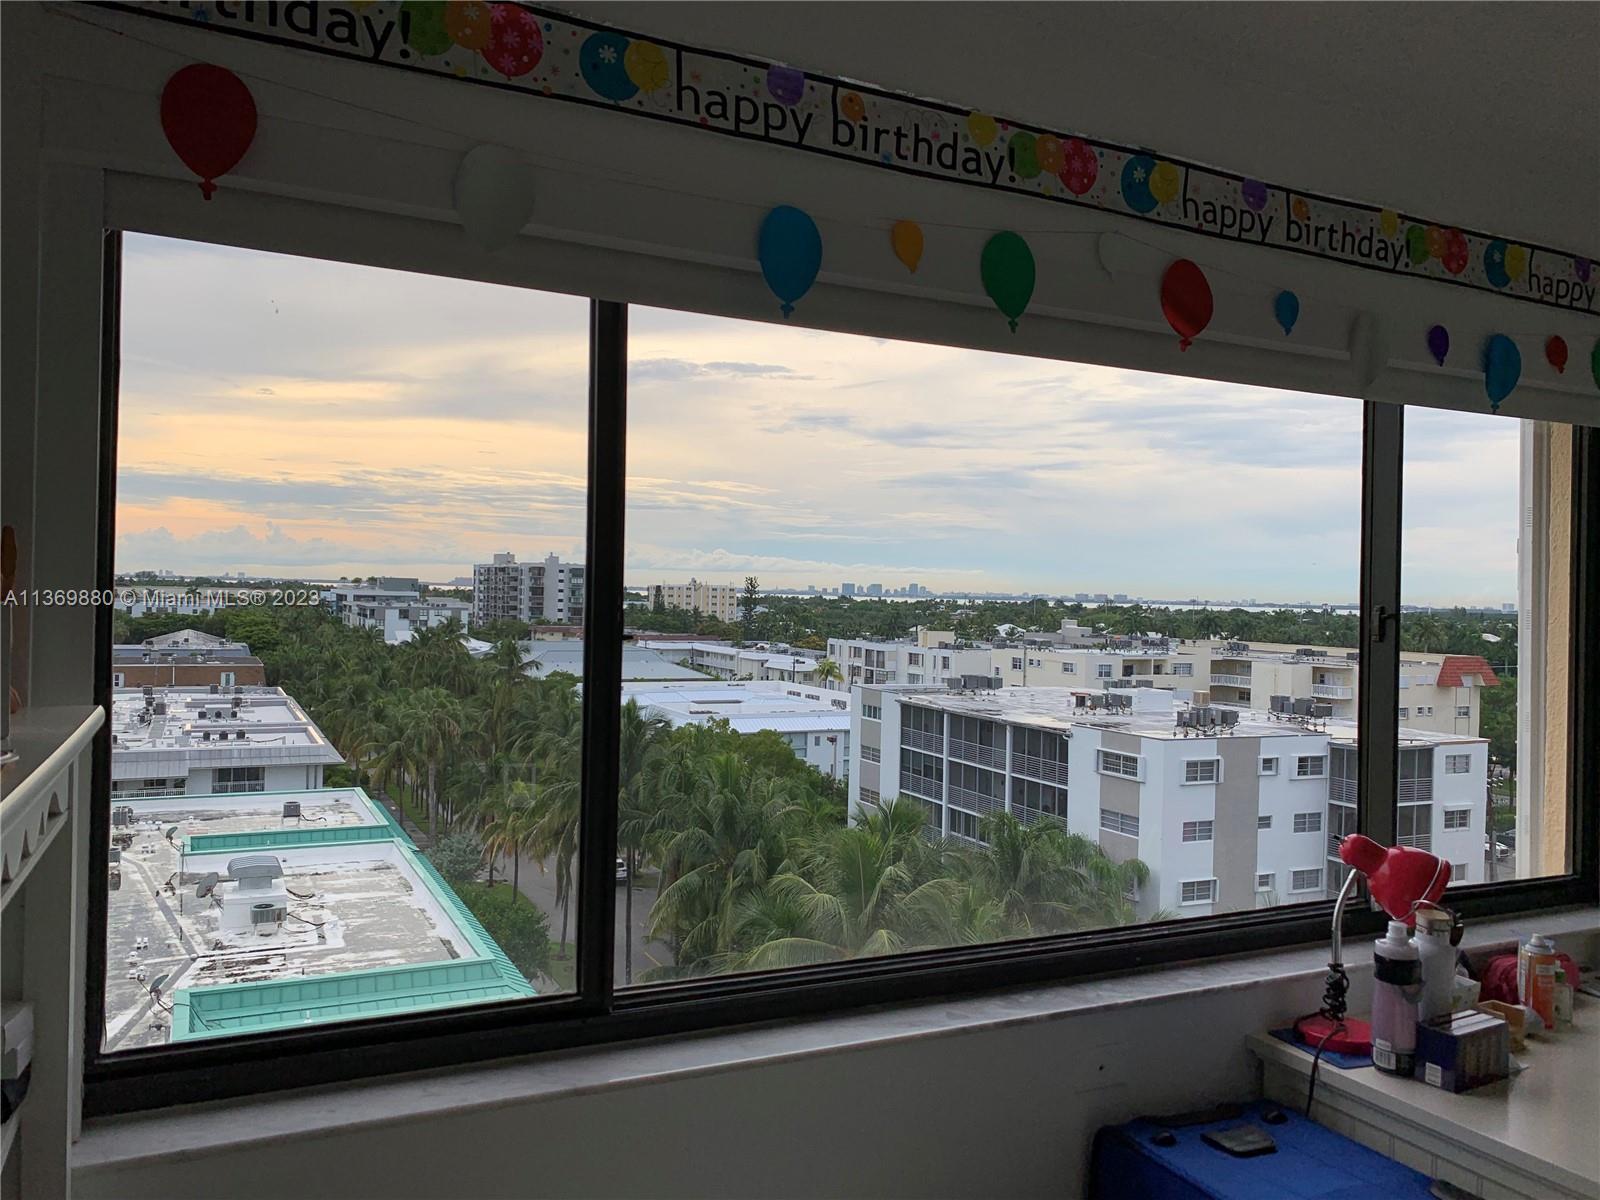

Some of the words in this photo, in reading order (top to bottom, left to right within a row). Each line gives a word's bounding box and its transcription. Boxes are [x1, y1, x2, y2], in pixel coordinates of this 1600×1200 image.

[677, 49, 813, 144] happy
[832, 84, 1016, 184] birthday!
[1183, 167, 1273, 242] happy
[1286, 191, 1410, 271] birthday!
[1529, 248, 1595, 309] happy
